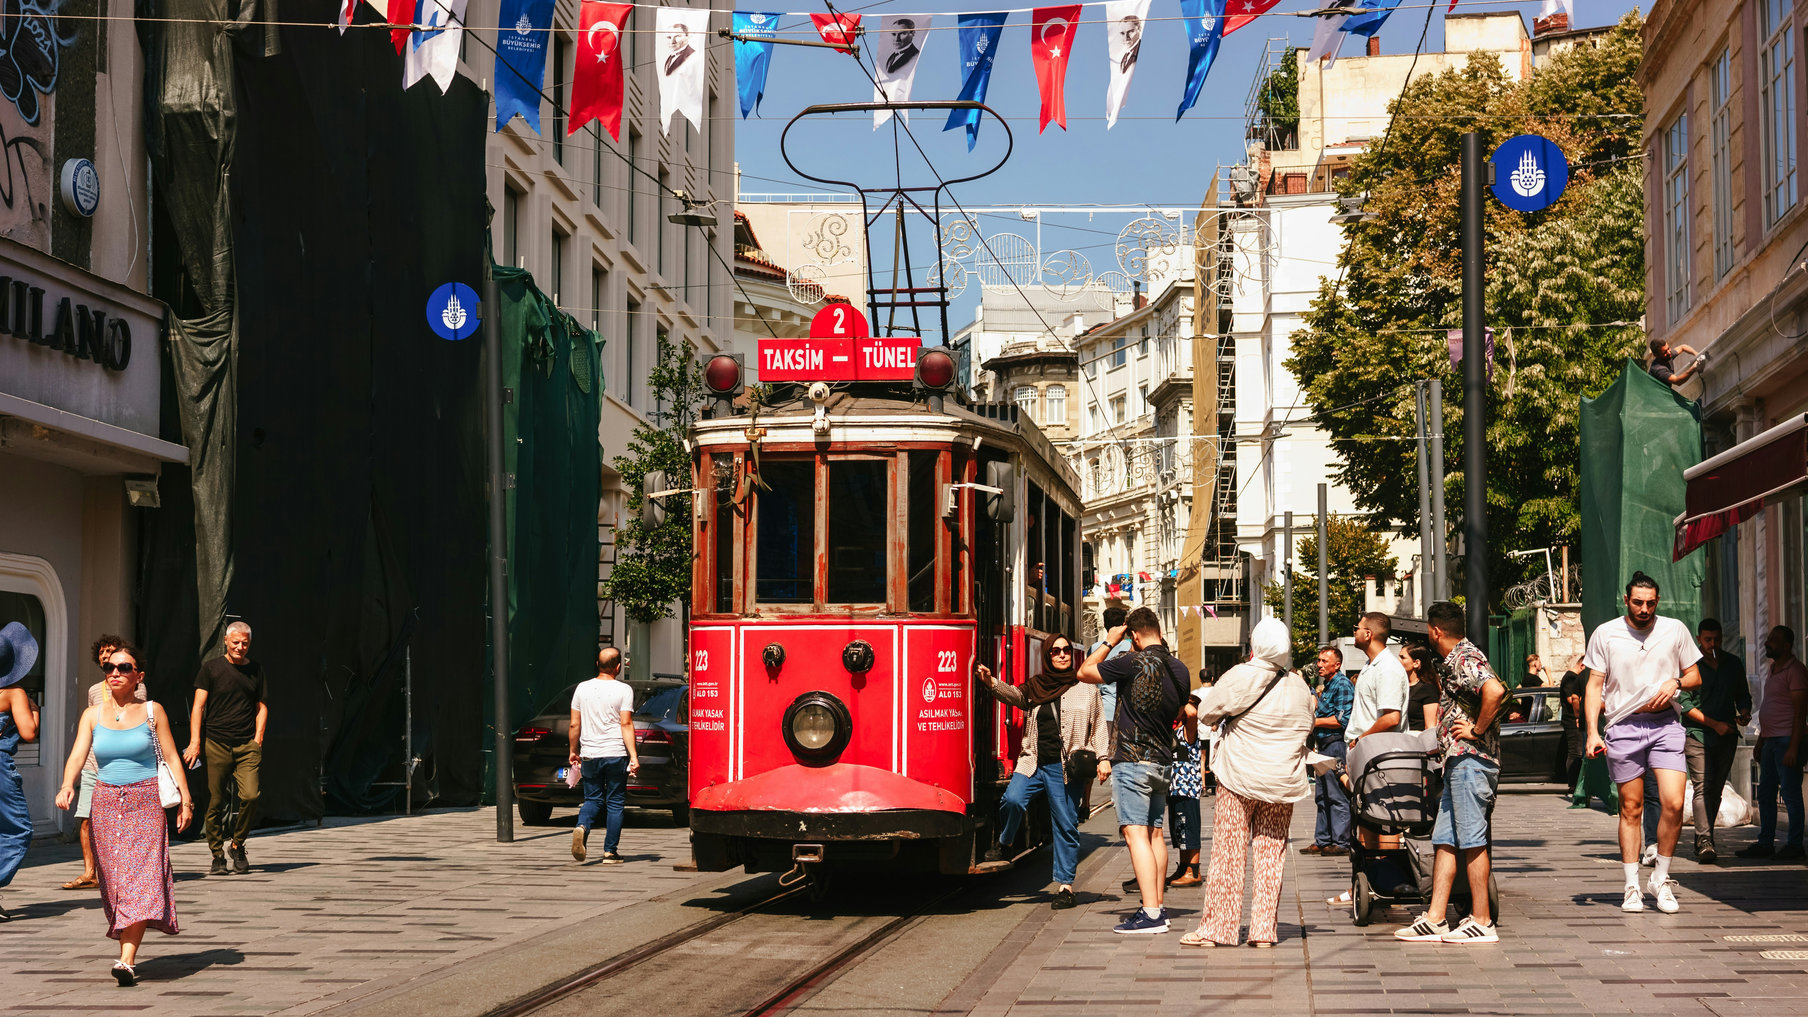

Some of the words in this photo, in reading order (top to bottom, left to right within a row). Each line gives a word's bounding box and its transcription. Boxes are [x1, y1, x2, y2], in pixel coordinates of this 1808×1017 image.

[833, 308, 845, 334] 2
[763, 343, 823, 370] TAKSİM
[863, 341, 916, 368] TÜNEL
[695, 650, 708, 671] 223
[938, 651, 957, 672] 223
[707, 690, 719, 698] 153
[938, 690, 952, 699] ALO
[953, 690, 962, 699] 153
[705, 709, 724, 718] YASAK
[919, 709, 948, 719] ASILMAK
[917, 722, 927, 732] VE
[928, 719, 965, 732] TEHLİKELİDİR
